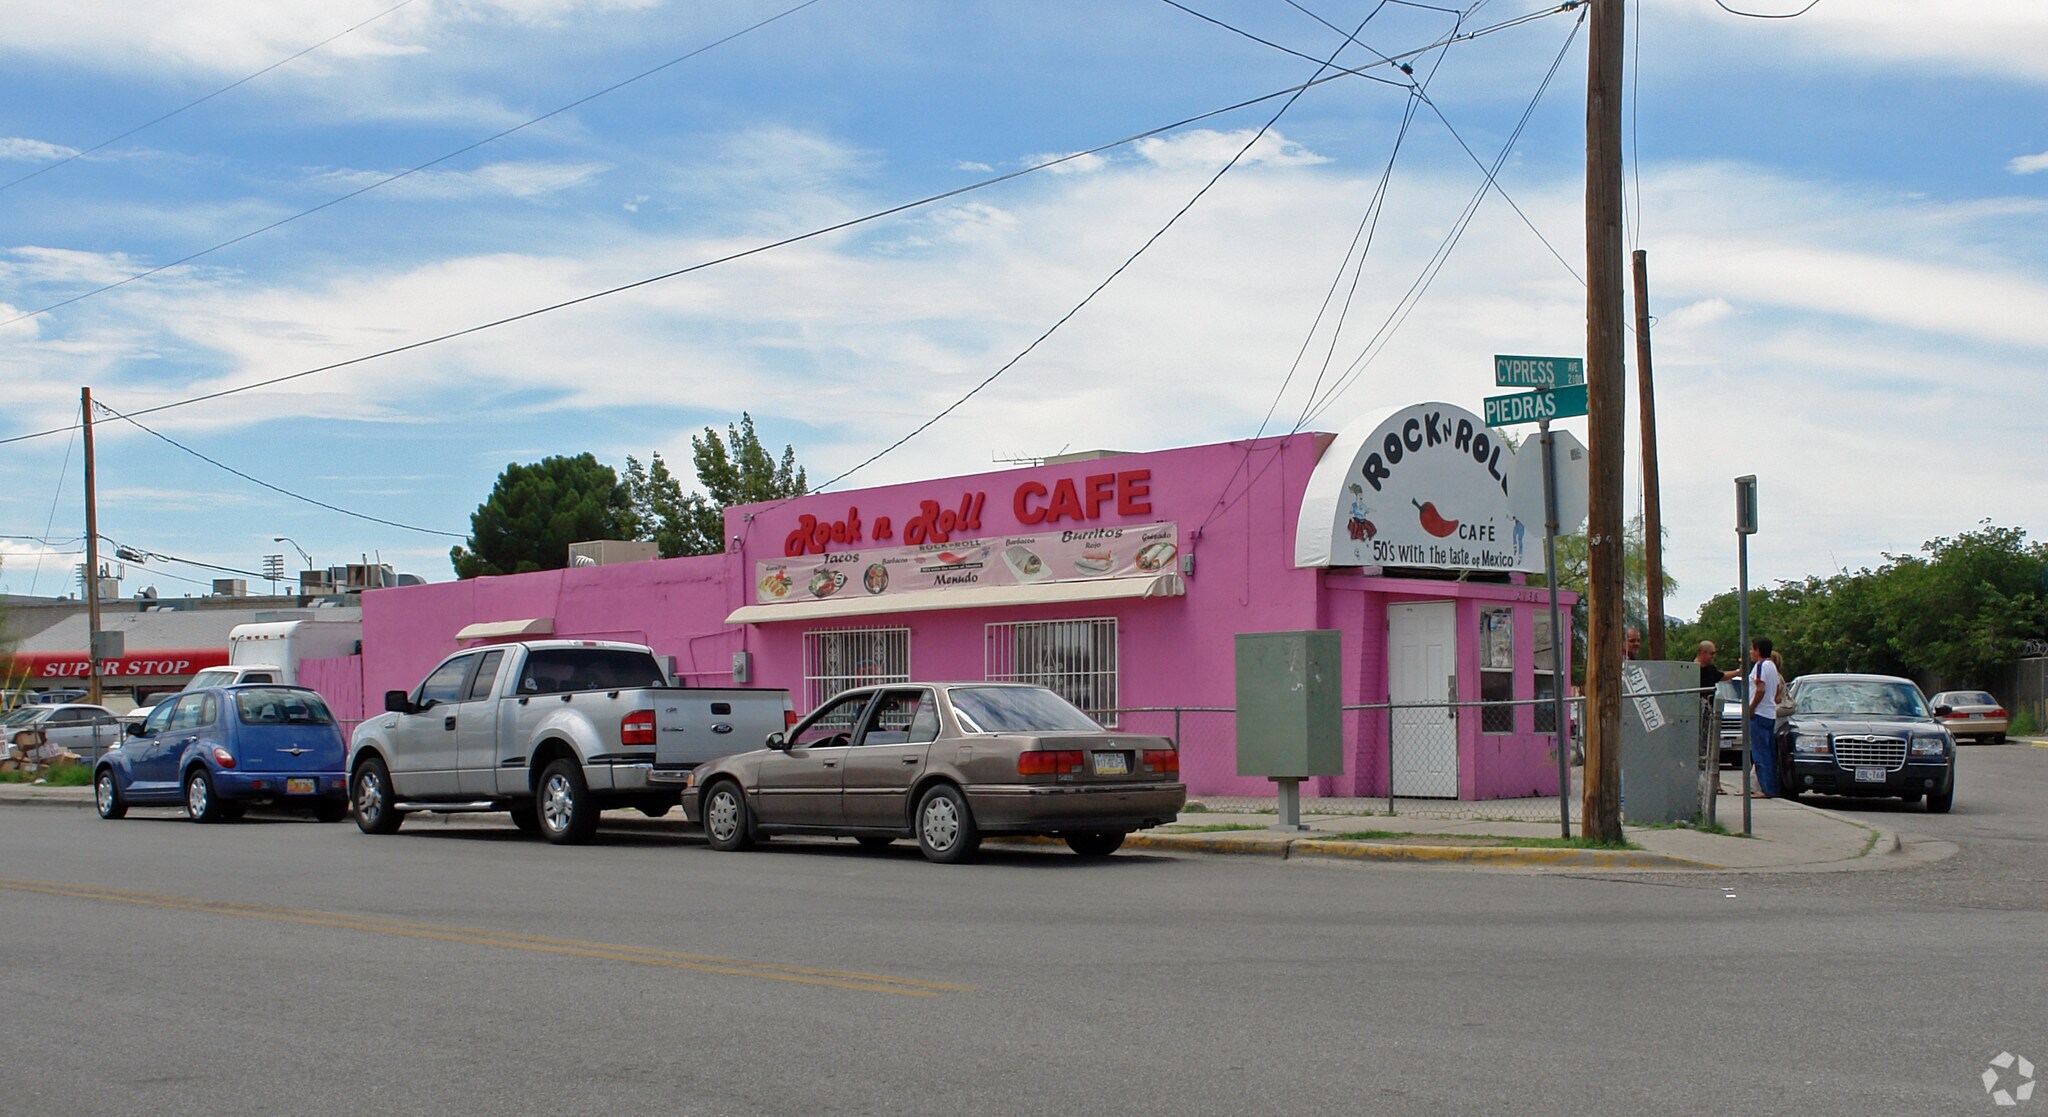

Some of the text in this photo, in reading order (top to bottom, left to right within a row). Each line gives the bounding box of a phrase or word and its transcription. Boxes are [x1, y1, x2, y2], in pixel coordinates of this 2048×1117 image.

[1496, 359, 1579, 384] CYPRESS AVE
[1486, 393, 1556, 423] PIEDRAS
[1362, 411, 1442, 492] ROCK
[1442, 417, 1452, 443] N
[784, 469, 1152, 557] Rock n Roll CAFE
[1061, 527, 1124, 543] Burritos
[1458, 516, 1496, 542] CAFÉ
[823, 552, 860, 564] Tacos
[1373, 539, 1396, 562] 50's
[1449, 545, 1470, 566] taste
[1481, 549, 1514, 568] Mexico
[933, 571, 979, 586] Menudo
[43, 660, 190, 677] SUPR STOP
[1629, 670, 1645, 686] El
